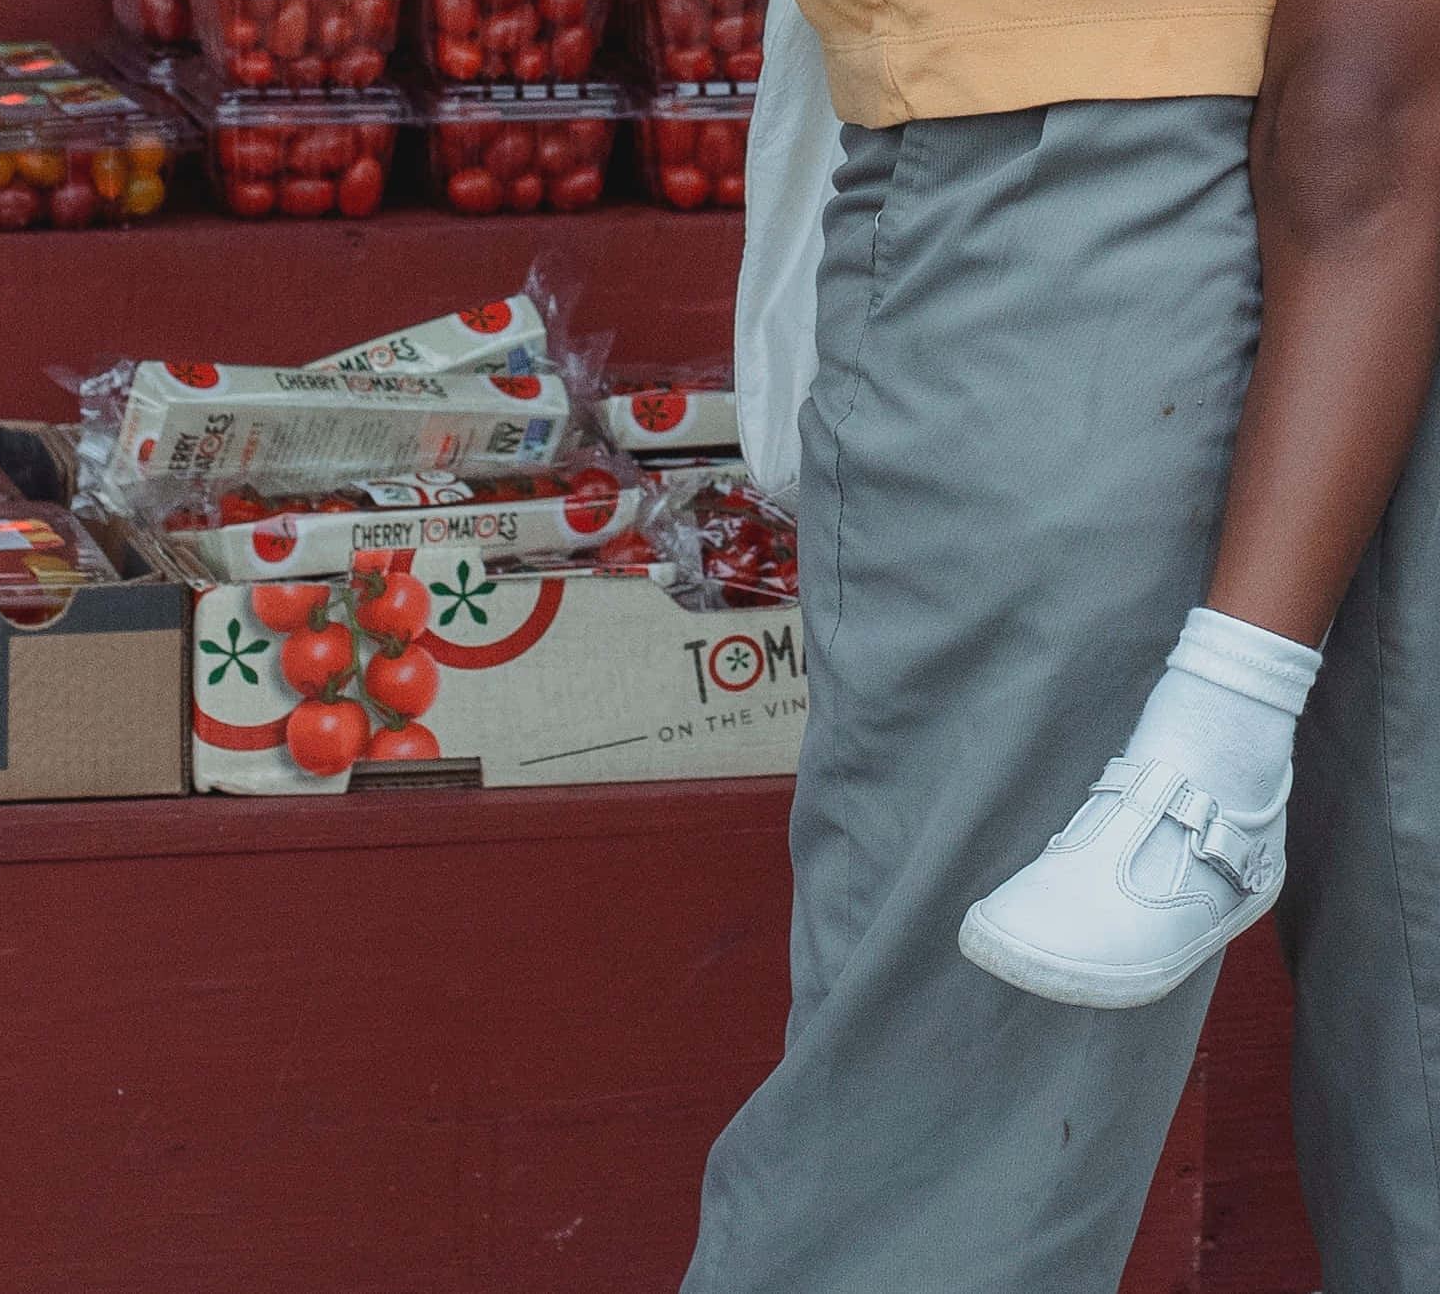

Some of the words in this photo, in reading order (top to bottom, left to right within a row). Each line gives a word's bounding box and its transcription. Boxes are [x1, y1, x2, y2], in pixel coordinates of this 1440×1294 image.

[318, 337, 421, 374] MATOES
[351, 523, 413, 550] CHERRY
[418, 511, 519, 545] TOMATOES
[658, 721, 693, 744] ON
[705, 708, 753, 733] THE
